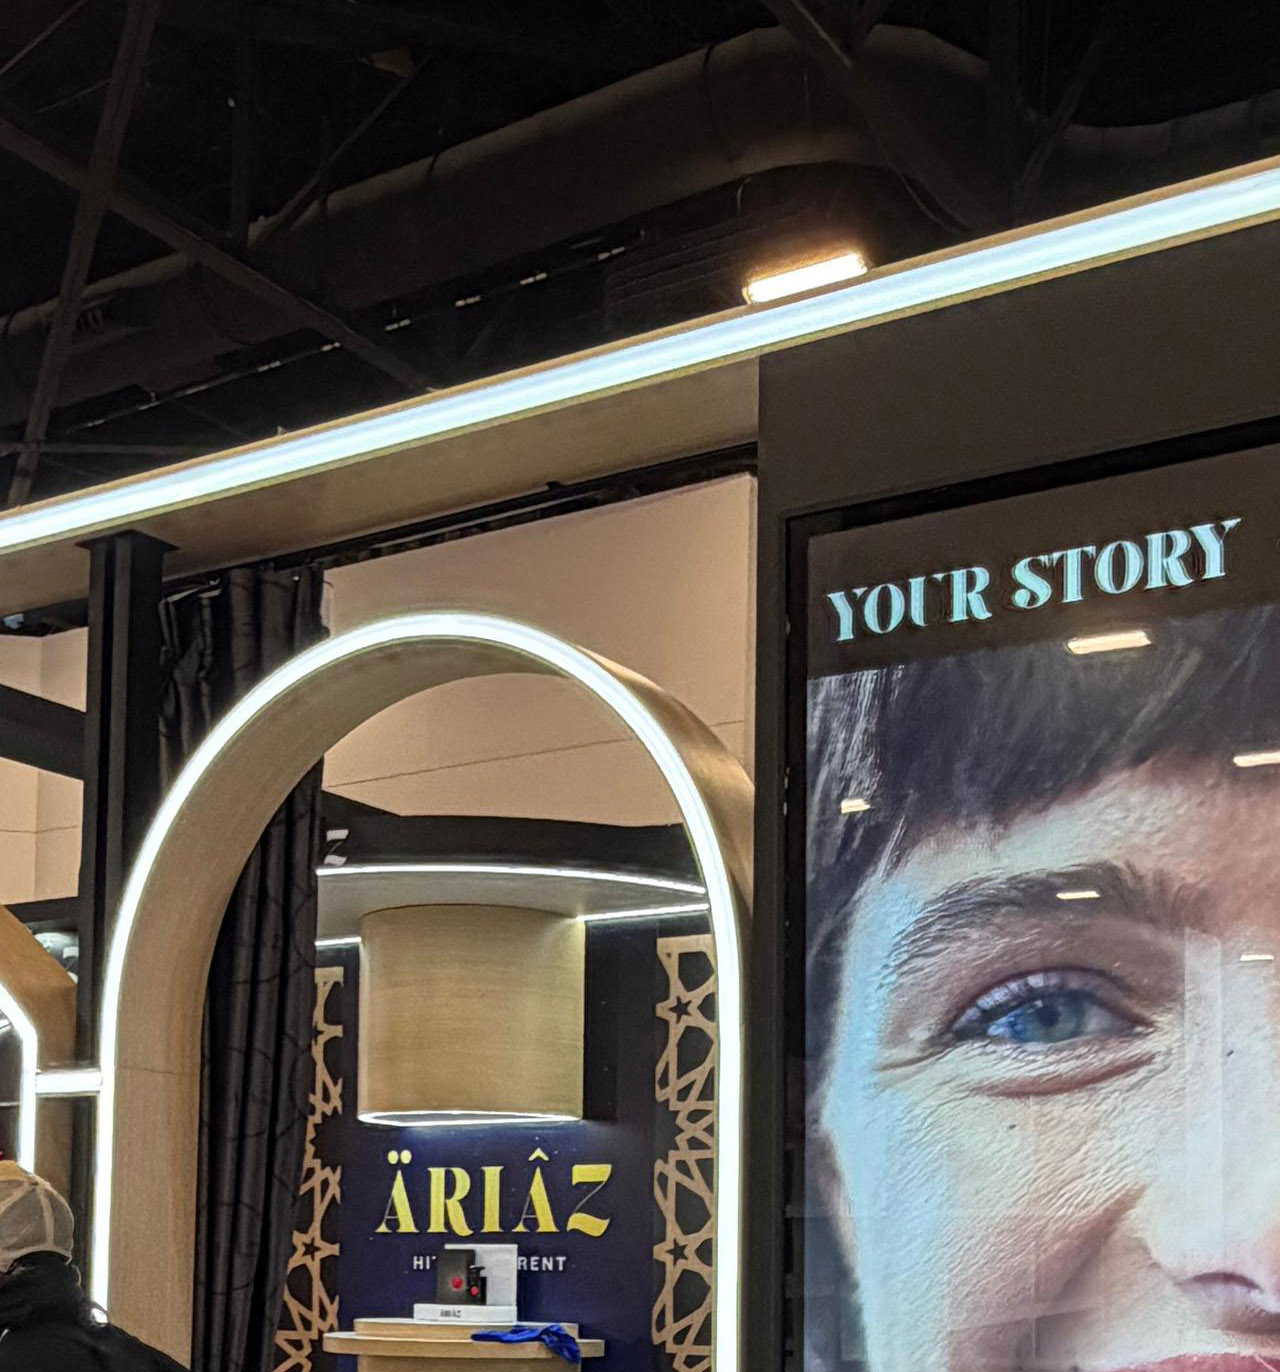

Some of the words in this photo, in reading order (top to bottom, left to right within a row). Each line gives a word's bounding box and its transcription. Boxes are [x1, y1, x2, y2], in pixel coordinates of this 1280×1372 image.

[826, 566, 993, 642] YOUR
[1011, 517, 1242, 609] STORY
[374, 1147, 612, 1237] ÄRIÂZ
[413, 1255, 437, 1271] HI
